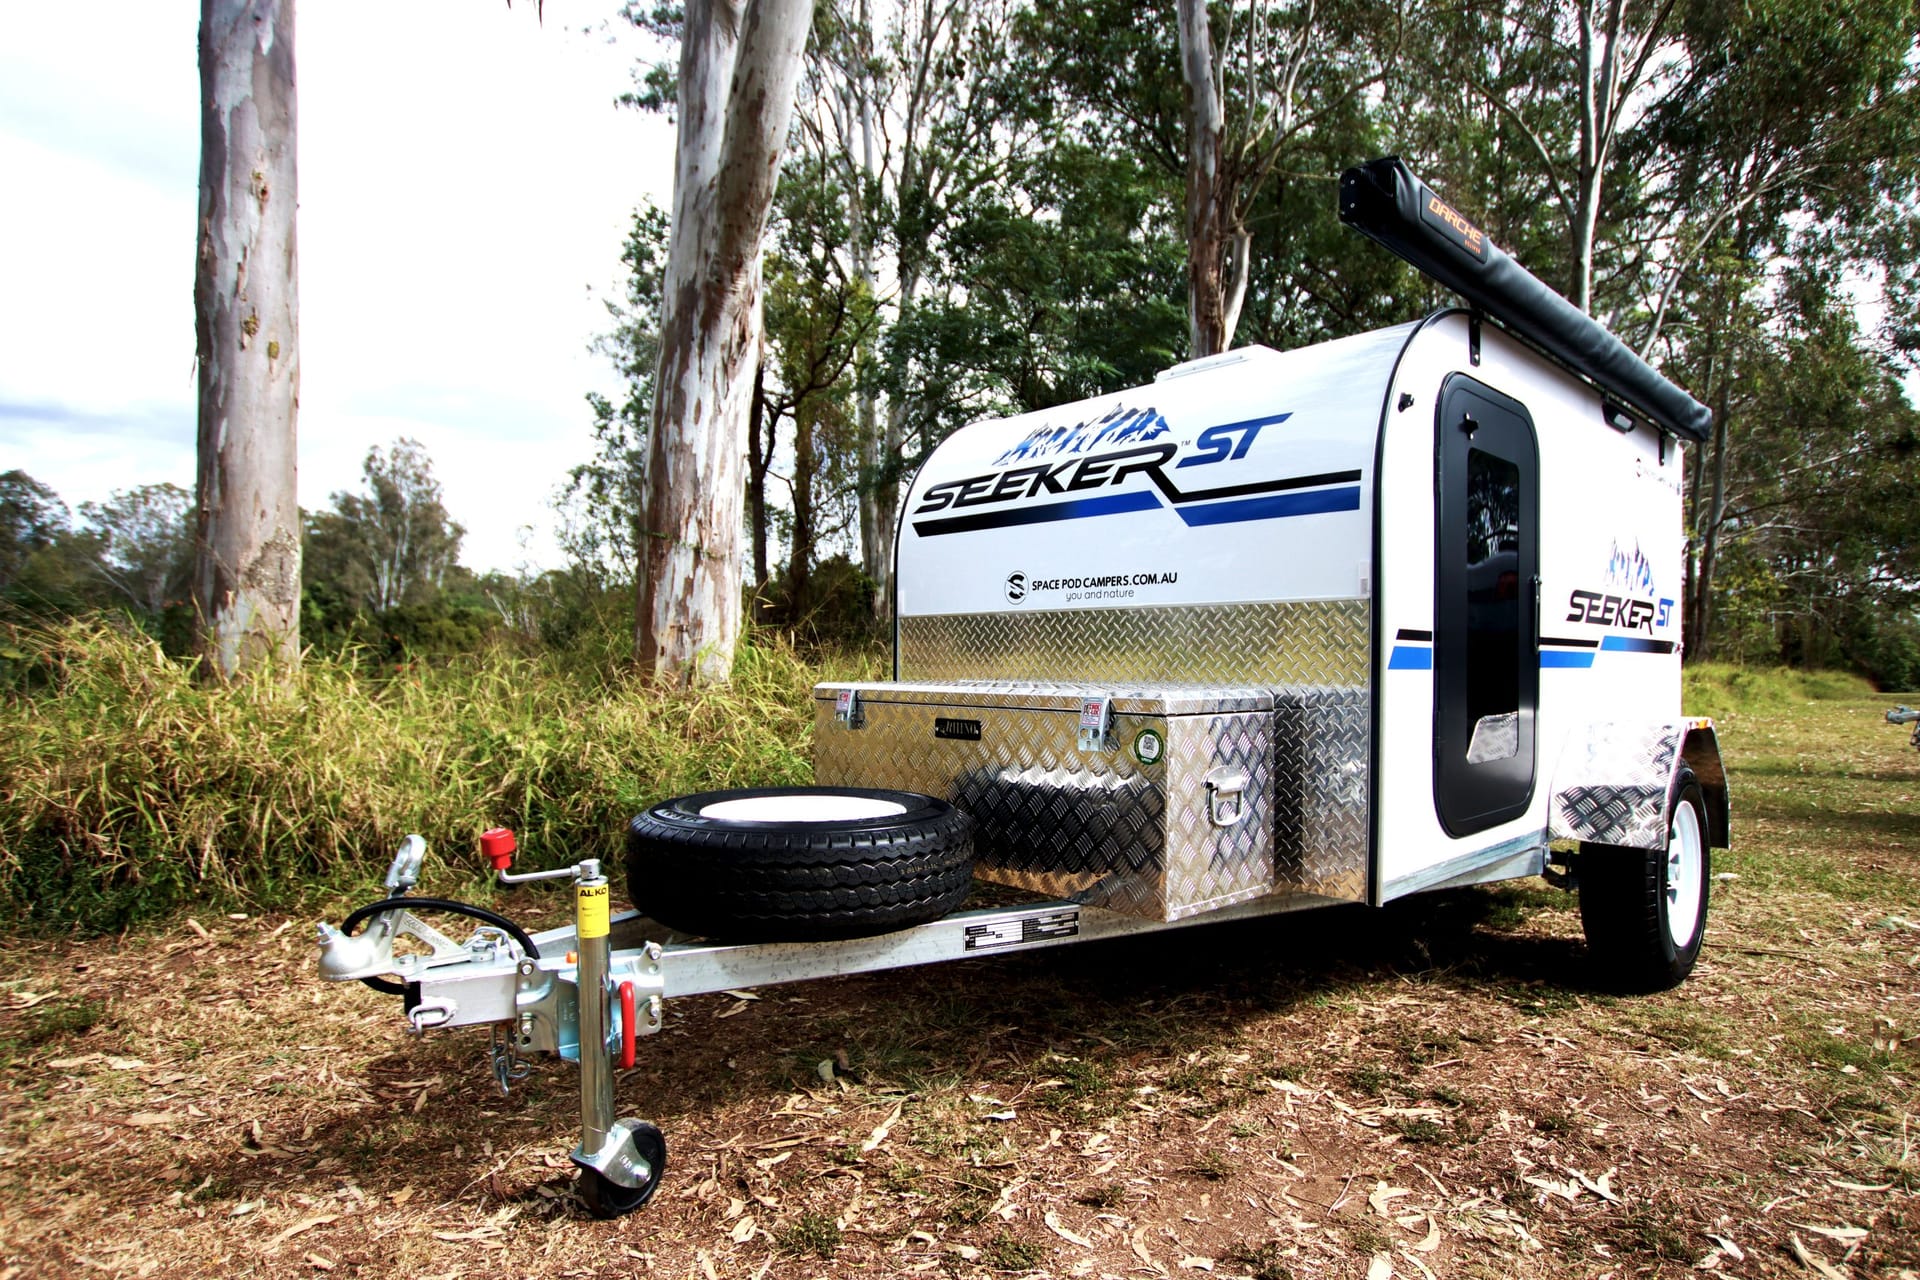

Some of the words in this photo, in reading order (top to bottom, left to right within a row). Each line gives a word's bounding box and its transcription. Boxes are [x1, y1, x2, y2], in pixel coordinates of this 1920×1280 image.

[1429, 197, 1483, 245] DARCHE
[913, 442, 1178, 514] SEEKER
[1175, 411, 1295, 469] ST
[1032, 579, 1060, 591] SPACE
[1061, 577, 1082, 589] POD
[1083, 572, 1178, 588] CAMPERS.COM.AU
[1066, 591, 1083, 602] you
[1084, 589, 1102, 600] and
[1103, 588, 1135, 598] nature
[1566, 589, 1655, 635] SEEKER
[1655, 597, 1675, 627] ST
